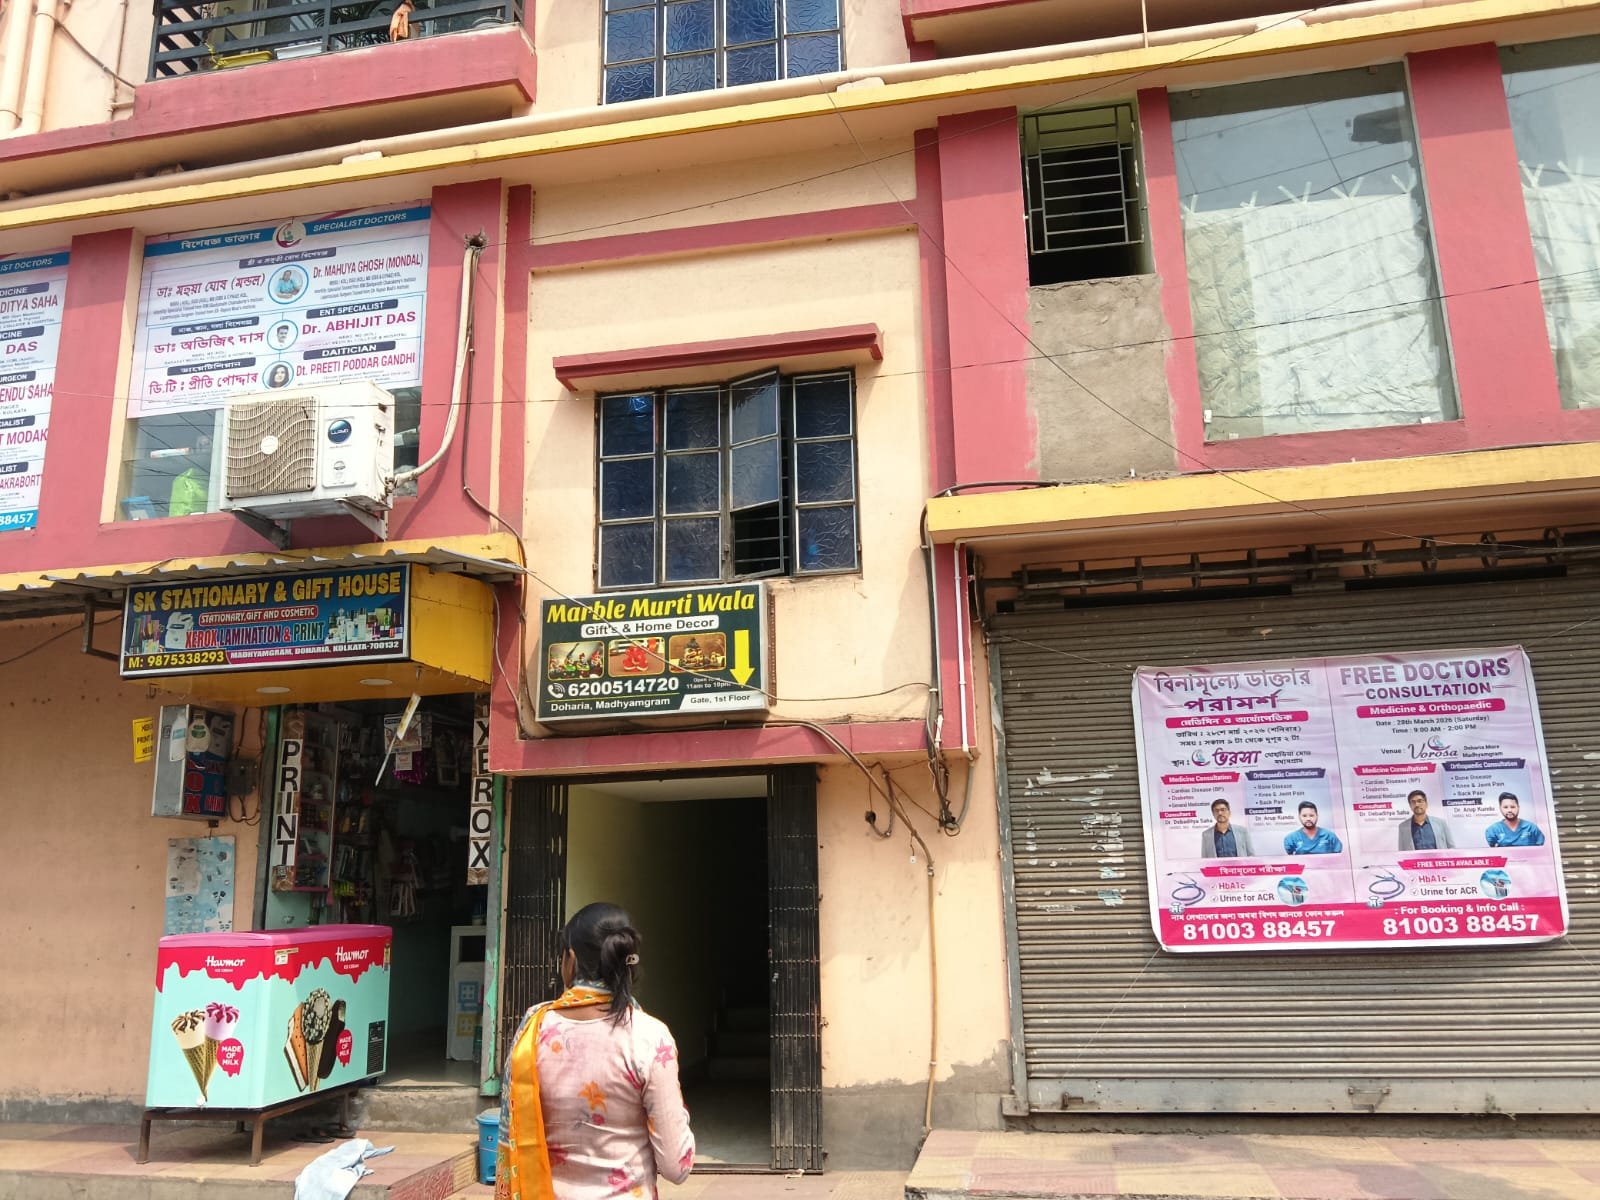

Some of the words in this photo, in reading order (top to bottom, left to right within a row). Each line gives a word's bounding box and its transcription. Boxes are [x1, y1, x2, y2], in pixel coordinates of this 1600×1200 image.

[313, 218, 362, 232] SPECIALIST
[363, 212, 406, 225] DOCTORS
[181, 237, 221, 250] বিশেষজ্ঞ
[224, 231, 260, 244] ডাক্তার
[15, 257, 53, 270] DOCTORS
[313, 266, 322, 278] Dr.
[324, 262, 356, 276] MAHUYA
[357, 258, 384, 272] GHOSH
[386, 253, 423, 272] (MONDAL)
[157, 287, 172, 297] ডাঃ
[176, 283, 202, 296] মহুয়া
[204, 279, 227, 293] ঘোষ
[231, 273, 265, 291] (মন্ডল)
[31, 294, 58, 310] SAHA
[319, 307, 335, 316] ENT
[336, 301, 385, 314] SPECIALIST
[302, 323, 321, 335] Dr.
[325, 315, 383, 331] ABHIJIT
[387, 311, 416, 325] DAS
[6, 341, 38, 355] DAS
[154, 342, 175, 354] ডাঃ
[181, 334, 235, 350] অভিজিৎ
[239, 332, 265, 344] দাস
[321, 344, 377, 357] DAITICIAN
[296, 365, 308, 376] Dt.
[310, 360, 341, 375] PREETI
[343, 356, 379, 371] PODDAR
[381, 352, 416, 367] GANDHI
[188, 375, 213, 390] প্রীতি
[217, 372, 259, 387] পোদ্দার
[28, 382, 52, 399] SAHA
[7, 428, 48, 446] MODAK
[0, 474, 43, 490] AKRABORT
[133, 590, 157, 613] SK
[161, 581, 270, 611] STATIONARY
[273, 580, 287, 602] &
[291, 576, 334, 600] GIFT
[338, 571, 401, 597] HOUSE
[263, 609, 280, 620] AND
[280, 606, 315, 618] COSMETIC
[546, 600, 625, 624] Marble
[628, 593, 692, 618] Murti
[697, 589, 756, 614] Wala
[283, 628, 291, 643] &
[293, 621, 325, 642] PRINT
[585, 623, 617, 637] Gift's
[622, 623, 631, 634] &
[635, 621, 672, 633] Home
[676, 618, 715, 630] Decor
[230, 648, 293, 661] MADHYAMGRAM,
[294, 645, 331, 656] DOHARIA,
[333, 641, 399, 653] KOLKATA-700132
[128, 656, 143, 669] M:
[147, 651, 225, 667] 9875338293
[1339, 665, 1397, 686] FREE
[1403, 657, 1511, 683] DOCTORS
[567, 676, 679, 697] 6200514720
[1154, 670, 1240, 697] বিনামূল্যে
[1243, 668, 1312, 688] ডাক্তার
[1365, 682, 1492, 700] CONSULTATION
[550, 702, 593, 713] Doharia,
[595, 697, 671, 711] Madhyamgram
[690, 696, 712, 705] Gate,
[715, 695, 727, 703] 1st
[729, 694, 750, 702] Floor
[1183, 689, 1283, 713] পরামর্শ
[1369, 704, 1416, 715] Medicine
[1419, 704, 1426, 713] &
[1429, 701, 1492, 714] Orthopaedic
[1181, 716, 1220, 728] মেডিসিন
[1454, 715, 1490, 724] (Saturday)
[1211, 748, 1262, 766] ভরসা
[1407, 743, 1458, 760] Vorosa
[1462, 750, 1503, 759] Madhyamgram
[1361, 766, 1390, 774] Medicine
[1390, 765, 1428, 773] Consultation
[1483, 760, 1518, 768] Consultation
[1168, 776, 1194, 784] Medicine
[1195, 774, 1233, 782] Consultation
[276, 741, 301, 866] PRINT
[1455, 858, 1490, 866] AVAILABLE
[1218, 881, 1246, 890] HbA1c
[1418, 874, 1447, 883] HbA1c
[1219, 894, 1242, 904] Urine
[1243, 893, 1255, 902] for
[1257, 892, 1275, 902] ACR
[1420, 887, 1444, 897] Urine
[1445, 886, 1458, 896] for
[1460, 885, 1478, 895] ACR
[1400, 906, 1420, 915] For
[1421, 904, 1464, 916] Booking
[1465, 904, 1473, 913] &
[1476, 903, 1496, 913] Info
[1499, 902, 1519, 912] Call
[1183, 922, 1255, 940] 81003
[1261, 920, 1336, 939] 88457
[1382, 917, 1459, 935] 81003
[1466, 914, 1540, 933] 88457
[335, 946, 369, 961] Havmor
[205, 956, 245, 968] Havmor
[221, 1044, 242, 1053] MADE
[339, 1036, 351, 1045] MADE
[222, 1059, 239, 1067] MILK
[226, 1052, 236, 1060] OF
